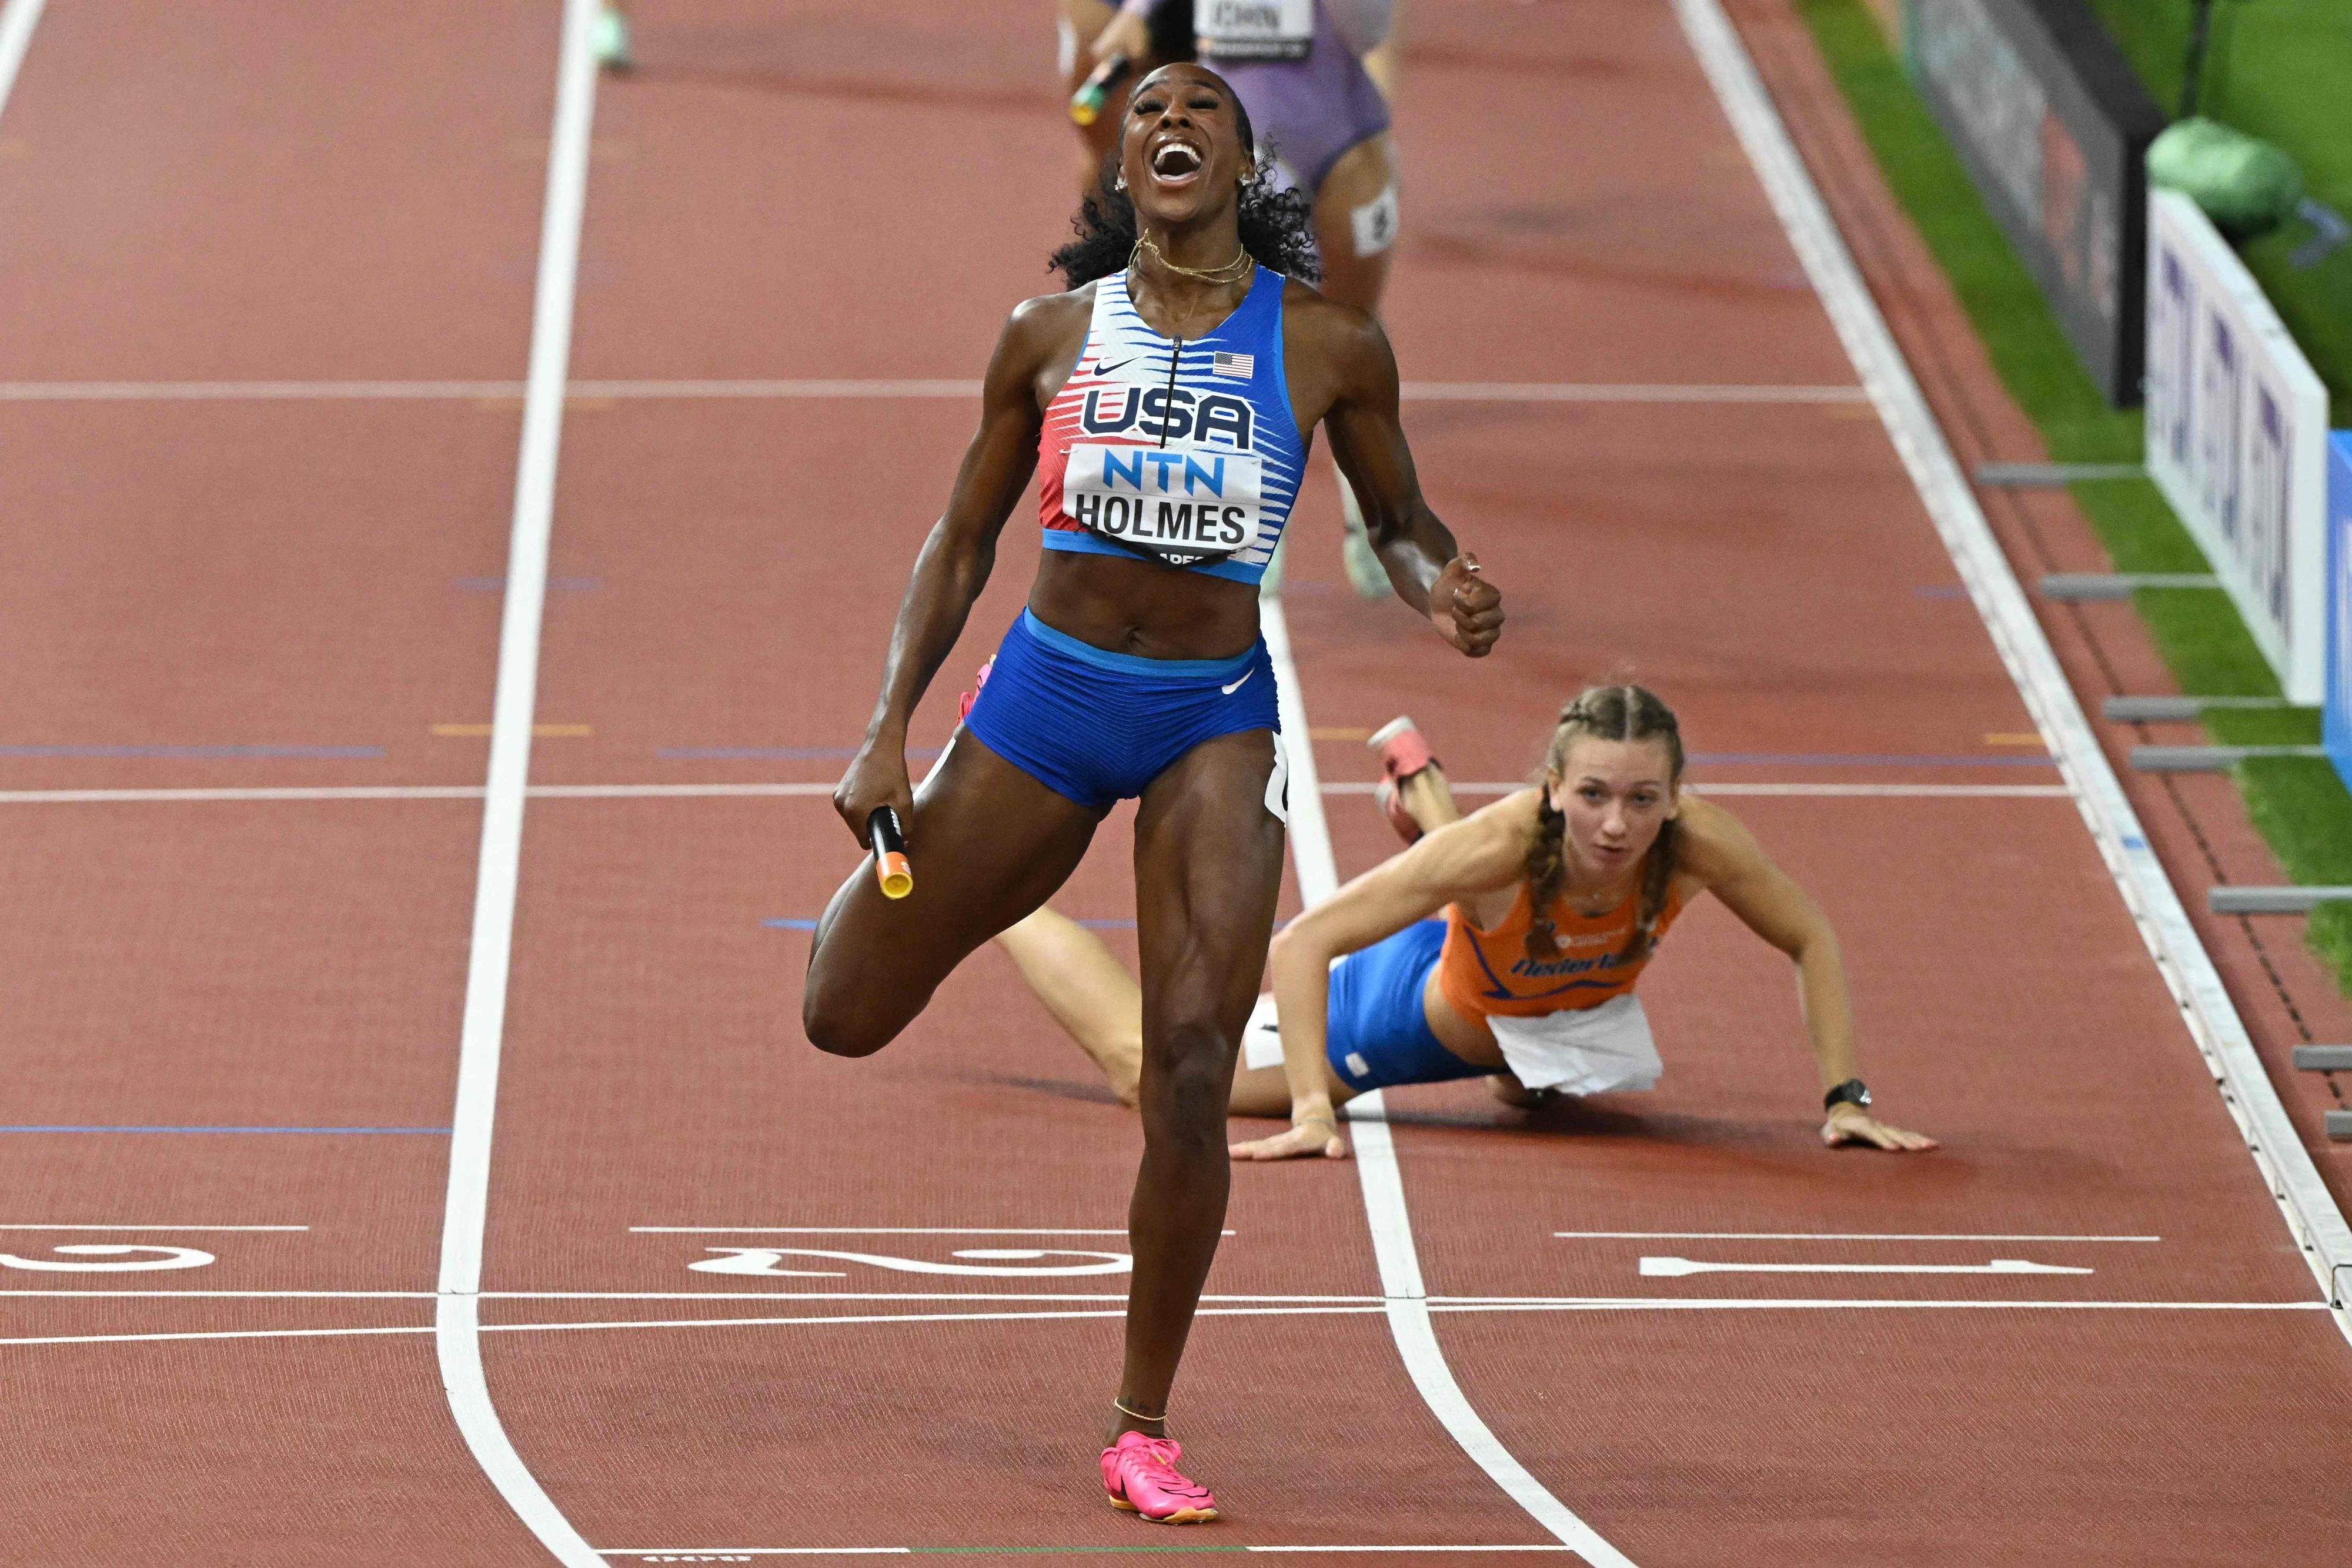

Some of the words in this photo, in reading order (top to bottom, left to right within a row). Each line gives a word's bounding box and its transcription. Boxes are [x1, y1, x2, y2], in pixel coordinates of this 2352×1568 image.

[1081, 386, 1254, 452] USA
[1103, 448, 1224, 499] NTN
[1075, 494, 1245, 544] HOLMES
